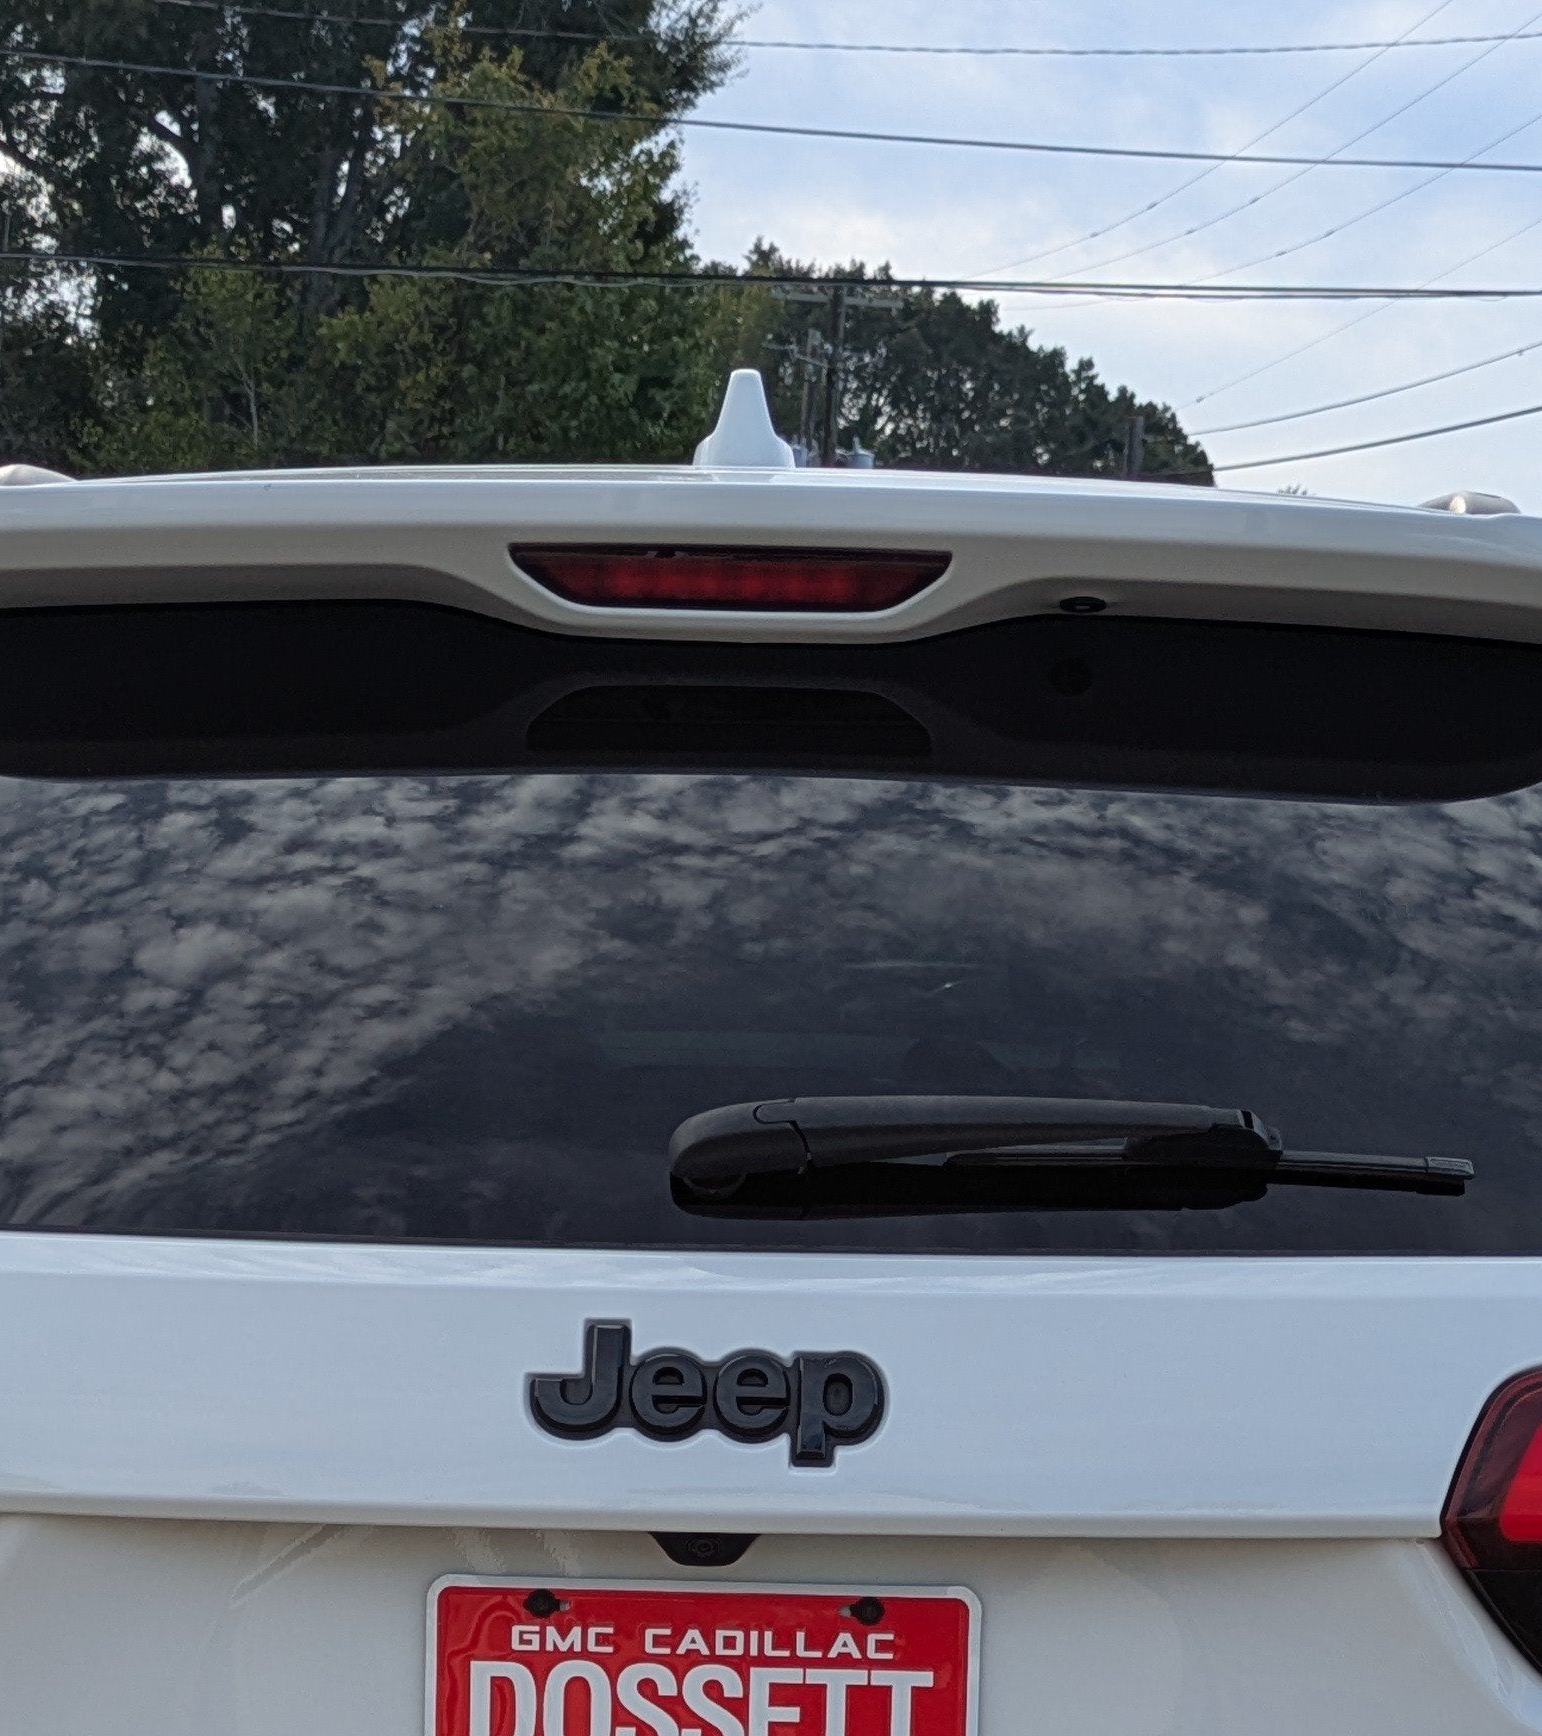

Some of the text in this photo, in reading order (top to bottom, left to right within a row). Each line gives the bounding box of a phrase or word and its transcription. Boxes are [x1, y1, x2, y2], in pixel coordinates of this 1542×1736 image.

[524, 1319, 887, 1468] Jeep
[512, 1625, 895, 1660] GMC CADILLAC
